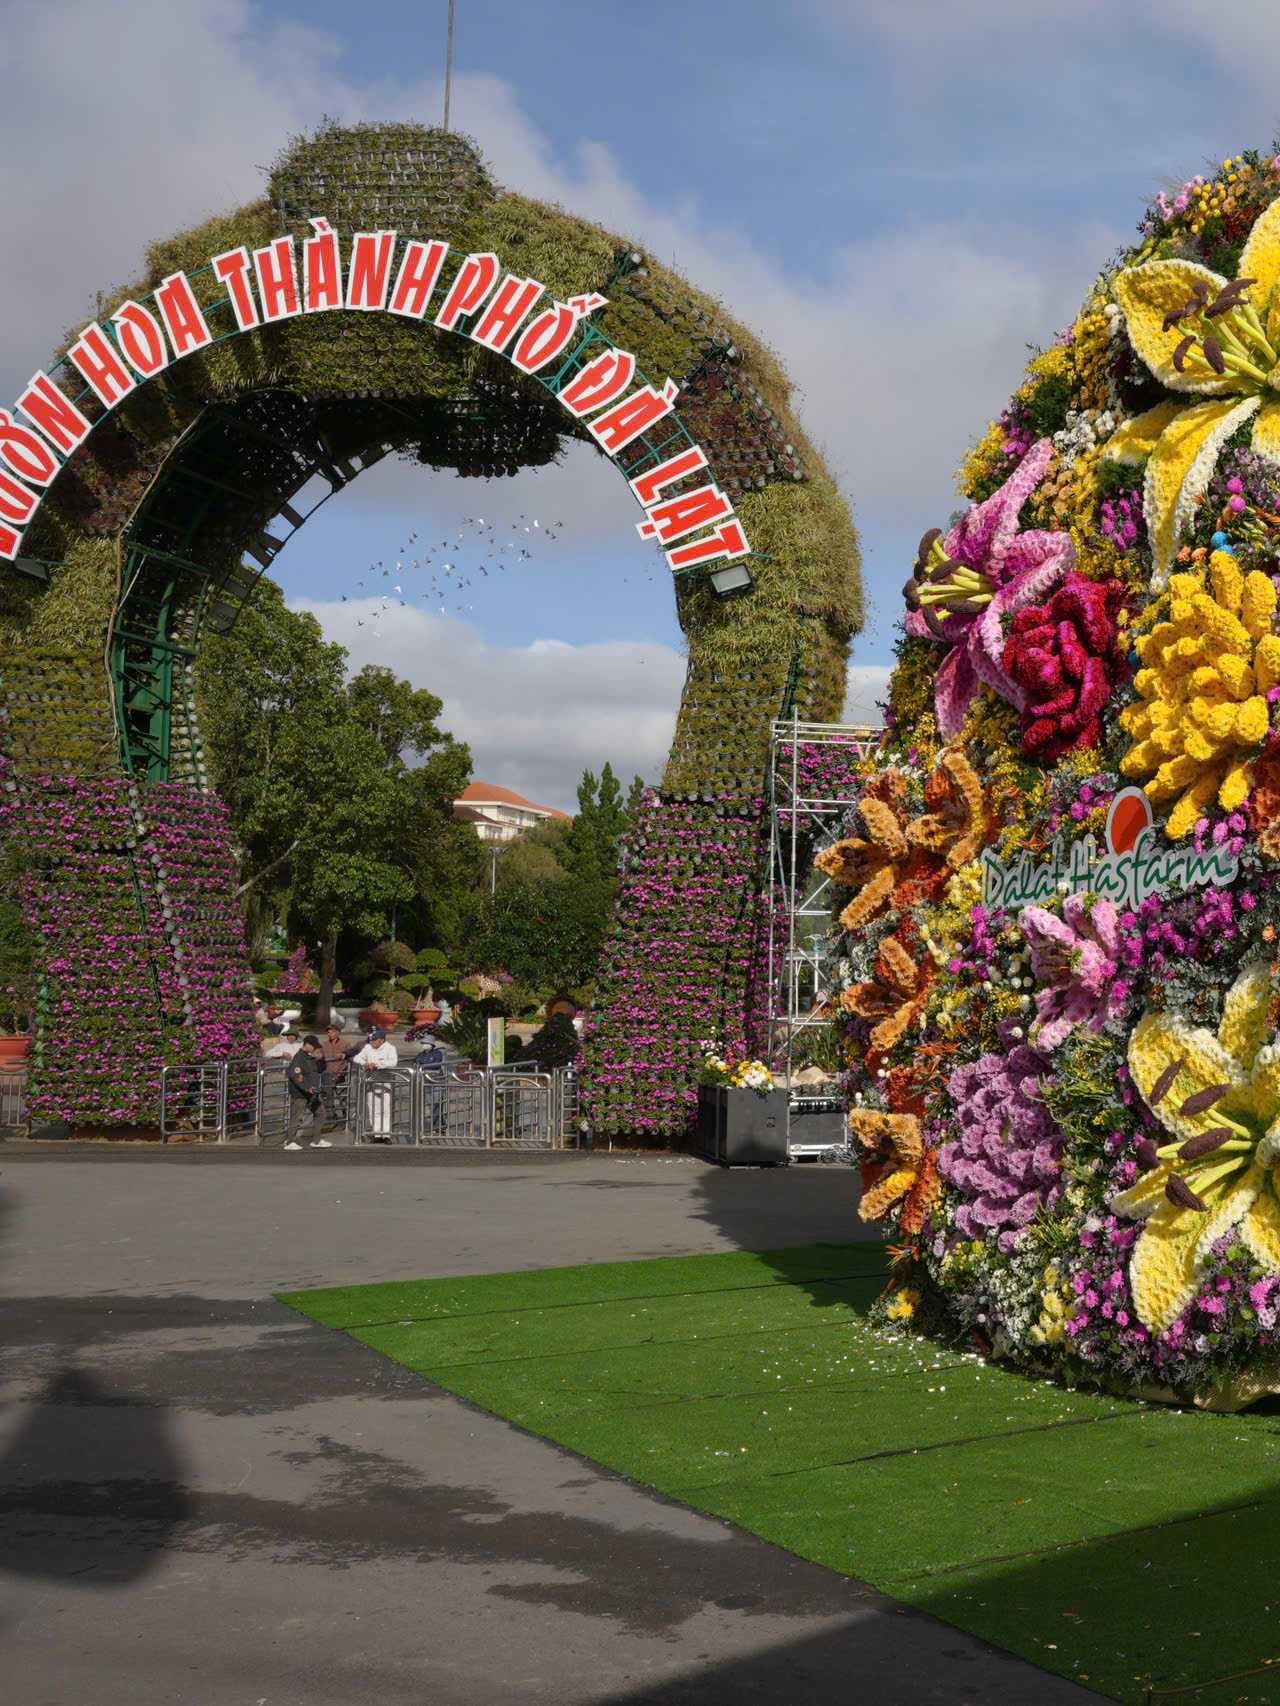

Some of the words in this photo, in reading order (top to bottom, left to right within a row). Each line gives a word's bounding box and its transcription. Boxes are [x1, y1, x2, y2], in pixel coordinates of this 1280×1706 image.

[68, 271, 212, 410] HOA
[211, 217, 449, 332] THÀNH
[434, 252, 609, 374] PHỐ
[556, 347, 679, 456] ĐÀ
[629, 445, 751, 570] LẠT
